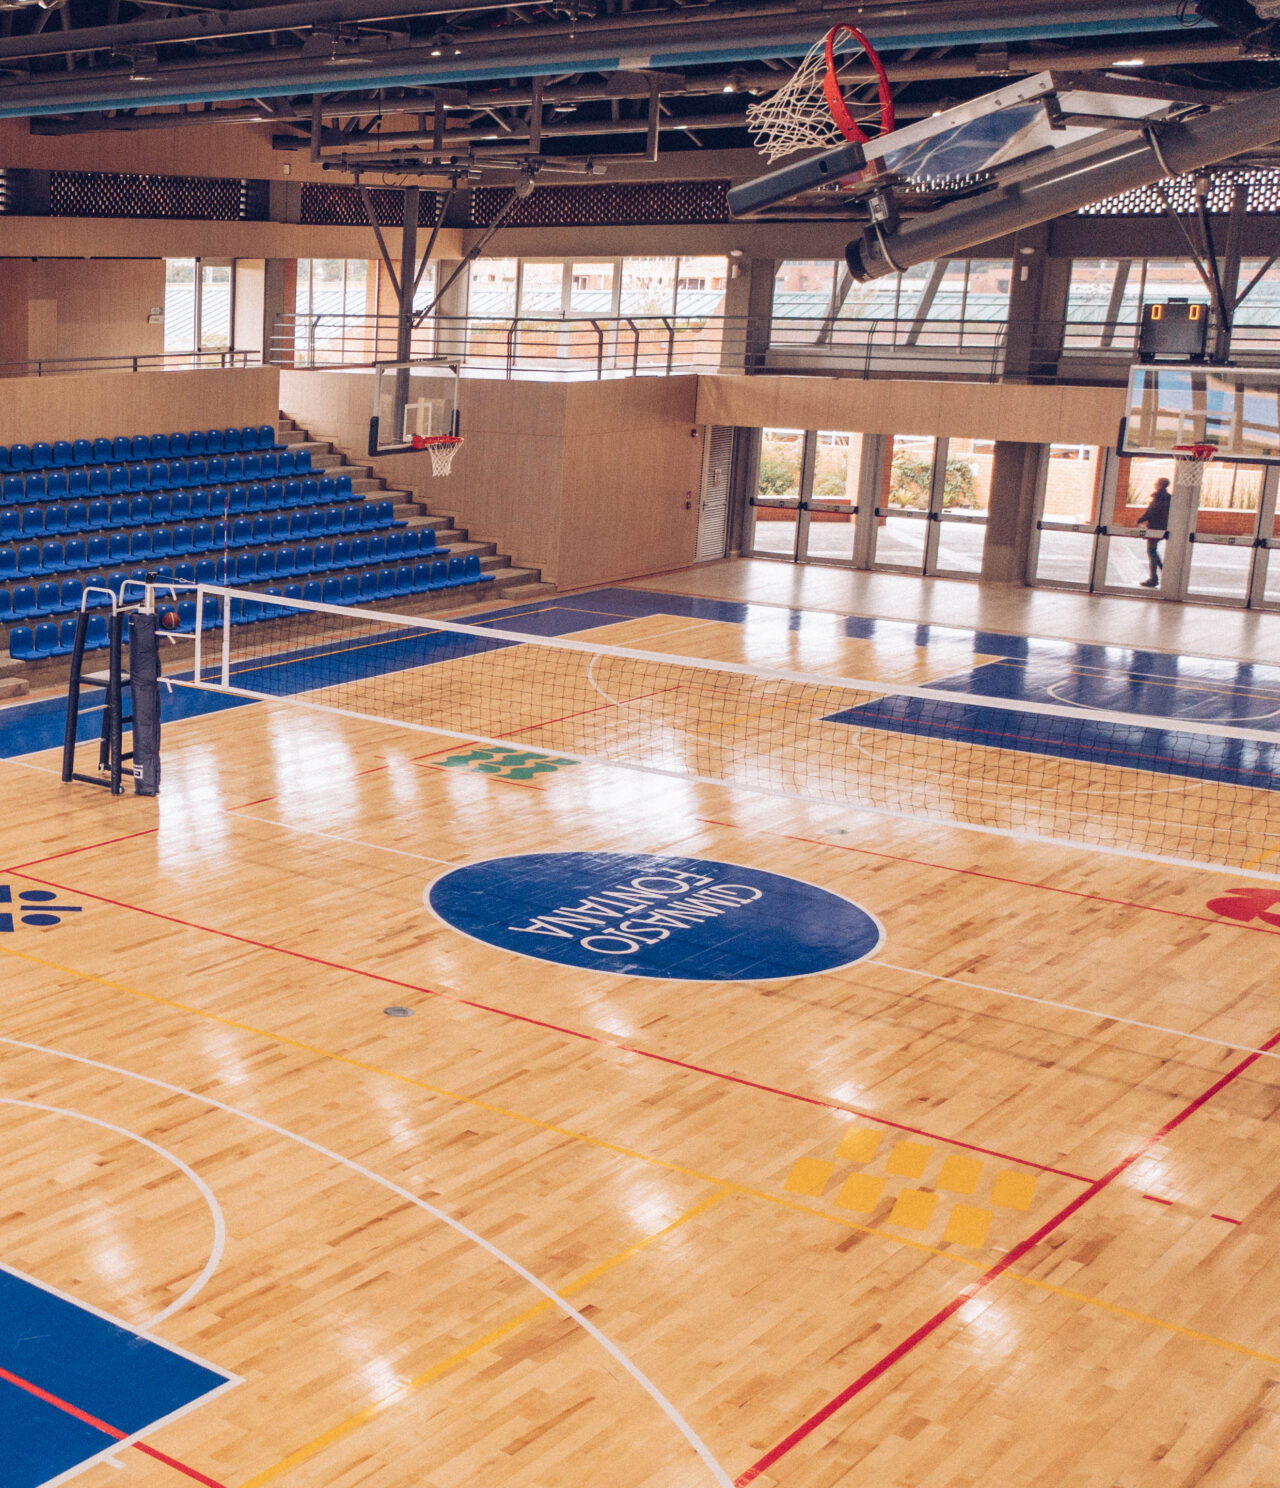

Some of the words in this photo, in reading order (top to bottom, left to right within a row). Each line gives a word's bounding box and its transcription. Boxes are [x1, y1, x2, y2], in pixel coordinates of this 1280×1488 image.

[1151, 304, 1161, 320] 0
[1189, 304, 1199, 320] 0
[507, 867, 715, 939] FONTANA
[580, 884, 763, 955] GIMNASIO
